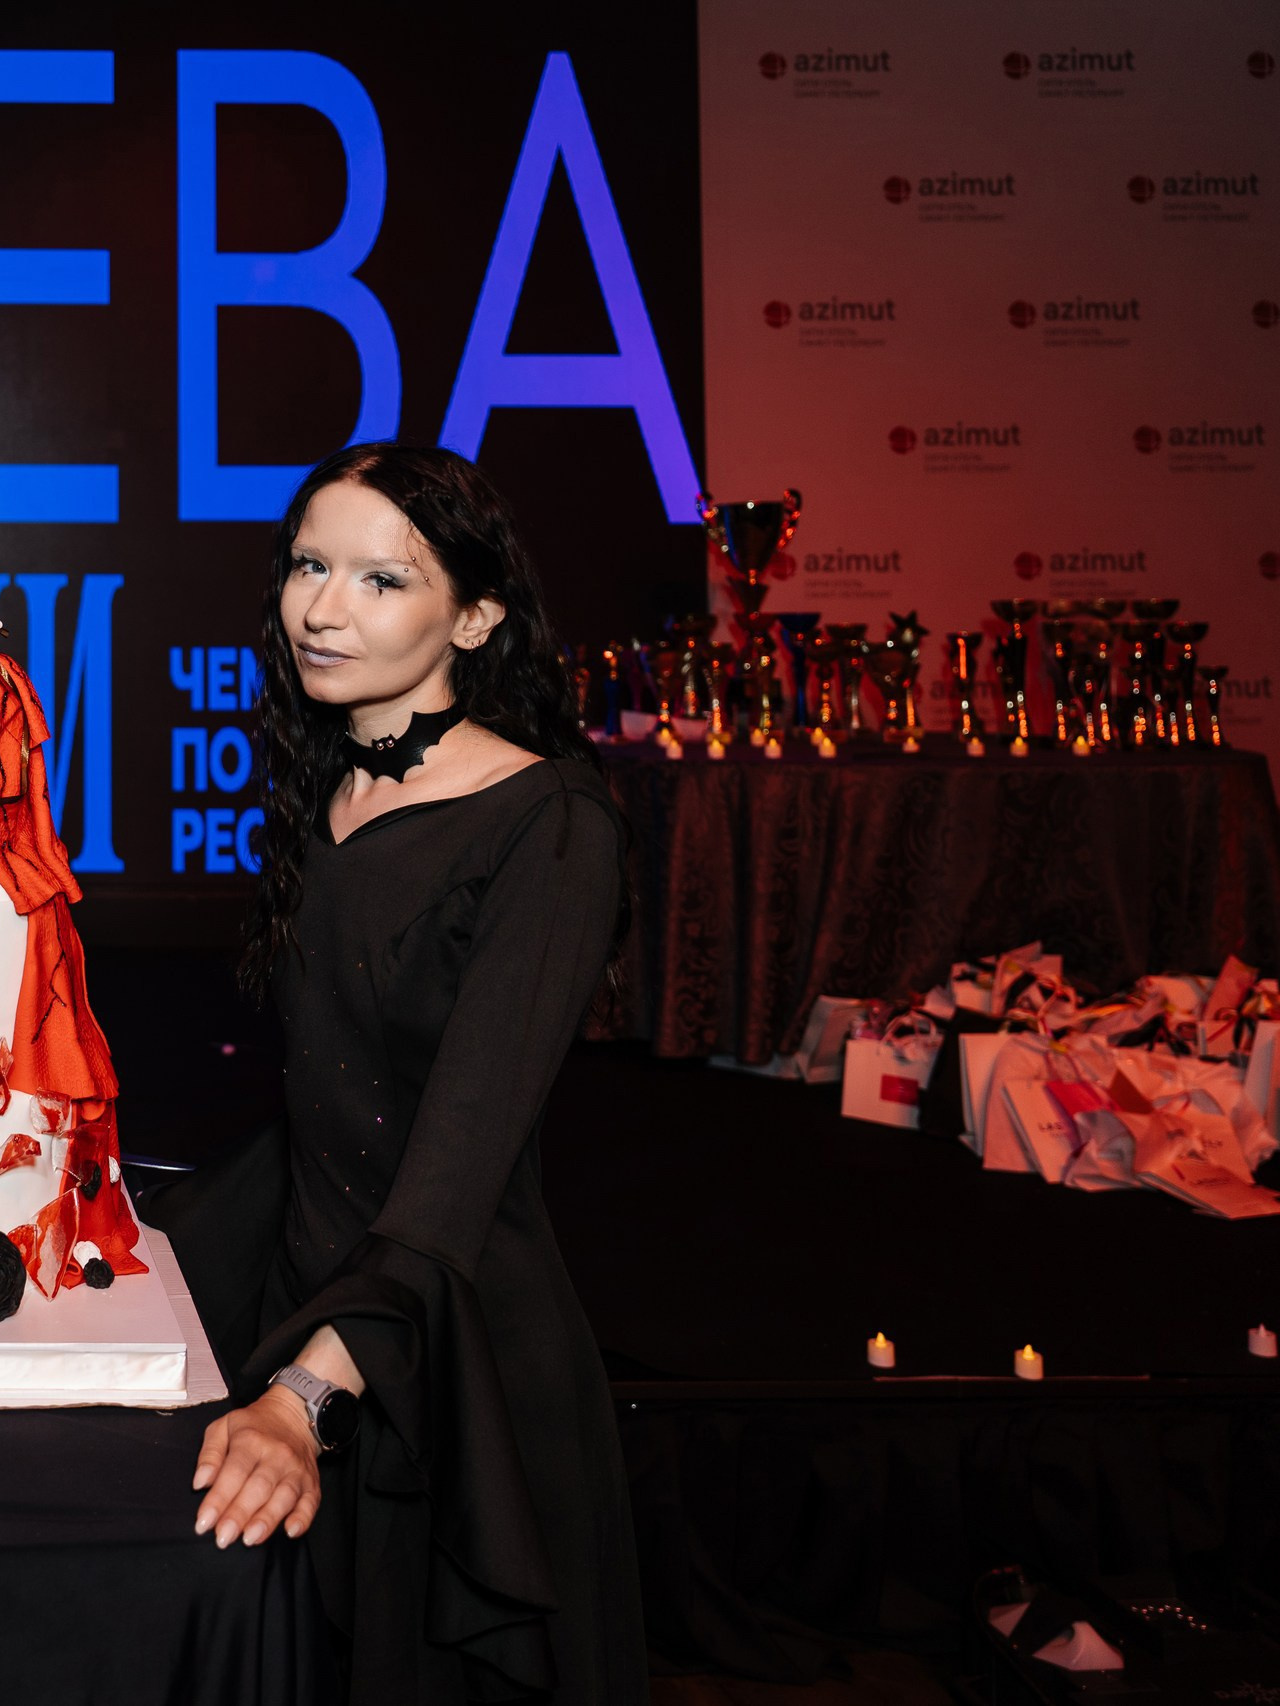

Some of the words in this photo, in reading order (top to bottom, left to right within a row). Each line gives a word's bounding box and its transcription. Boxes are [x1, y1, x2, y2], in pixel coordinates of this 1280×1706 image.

[794, 47, 891, 73] azimut
[1038, 47, 1136, 73] azimut
[918, 171, 1016, 197] azimut
[1162, 171, 1260, 197] azimut
[798, 296, 896, 322] azimut
[1044, 296, 1140, 322] azimut
[924, 421, 1021, 447] azimut
[1169, 421, 1266, 447] azimut
[804, 548, 901, 574] azimut
[1050, 548, 1147, 574] azimut
[170, 726, 253, 793] ПО
